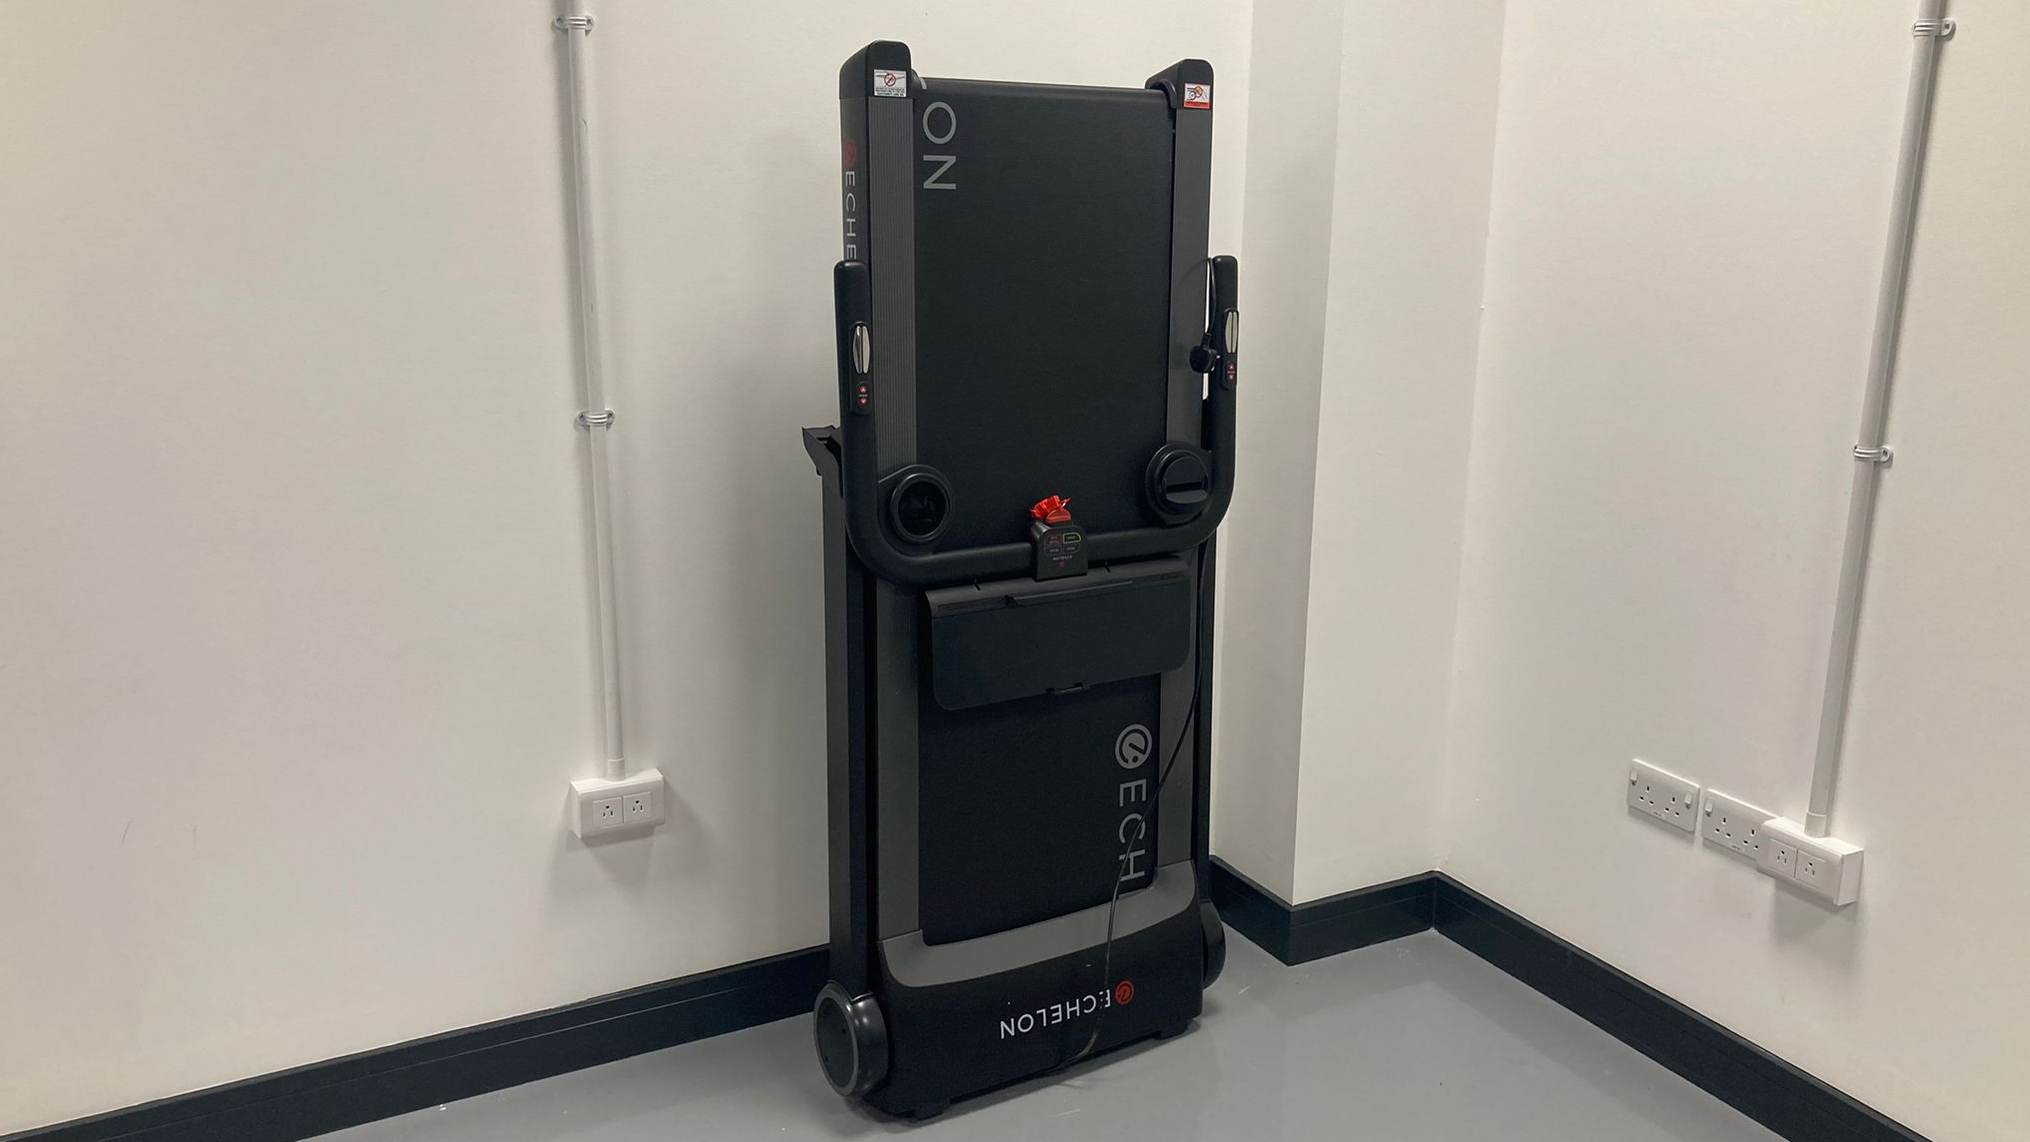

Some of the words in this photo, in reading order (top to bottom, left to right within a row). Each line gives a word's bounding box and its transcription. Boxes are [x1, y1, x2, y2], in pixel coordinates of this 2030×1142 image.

[919, 78, 957, 190] ON
[1119, 778, 1147, 882] ECH
[999, 988, 1111, 1040] ECHELON
